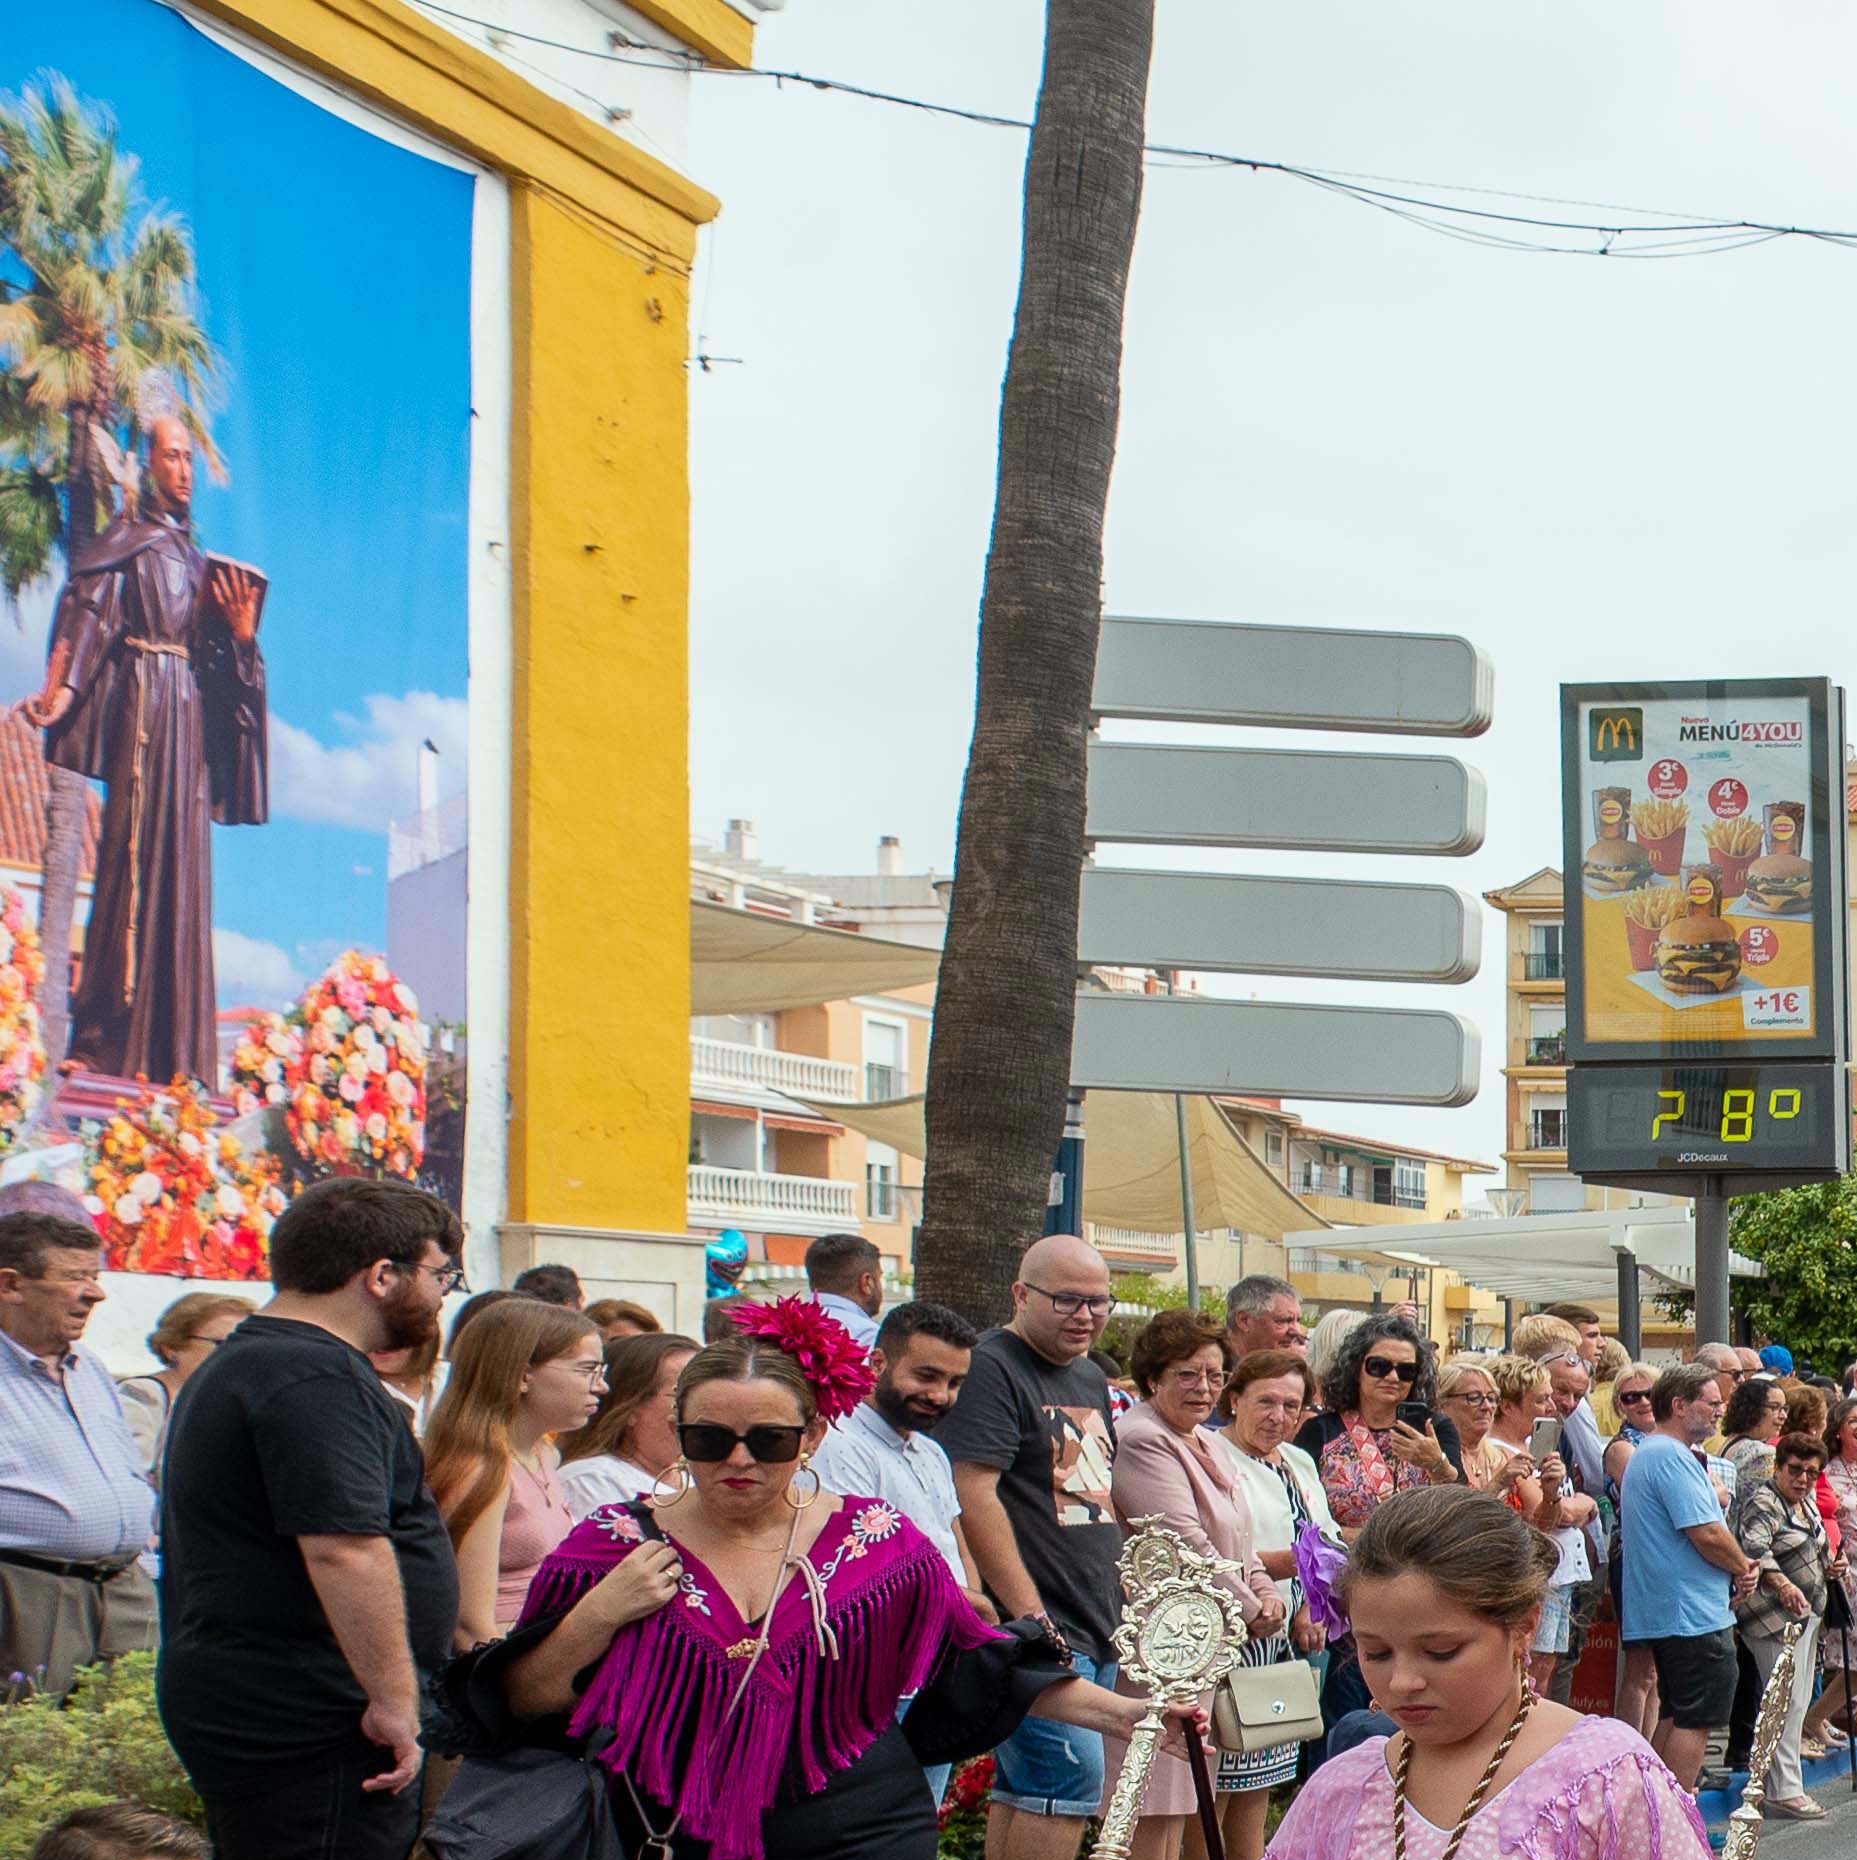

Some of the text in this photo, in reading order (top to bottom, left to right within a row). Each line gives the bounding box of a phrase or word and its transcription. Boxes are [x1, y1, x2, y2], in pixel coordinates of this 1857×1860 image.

[1680, 716, 1710, 725] Nuevo
[1680, 719, 1802, 742] MENÚ 4YOU
[1754, 991, 1801, 1013] +1€
[1750, 1016, 1805, 1027] Complemento
[1677, 1152, 1729, 1163] JCDecaux
